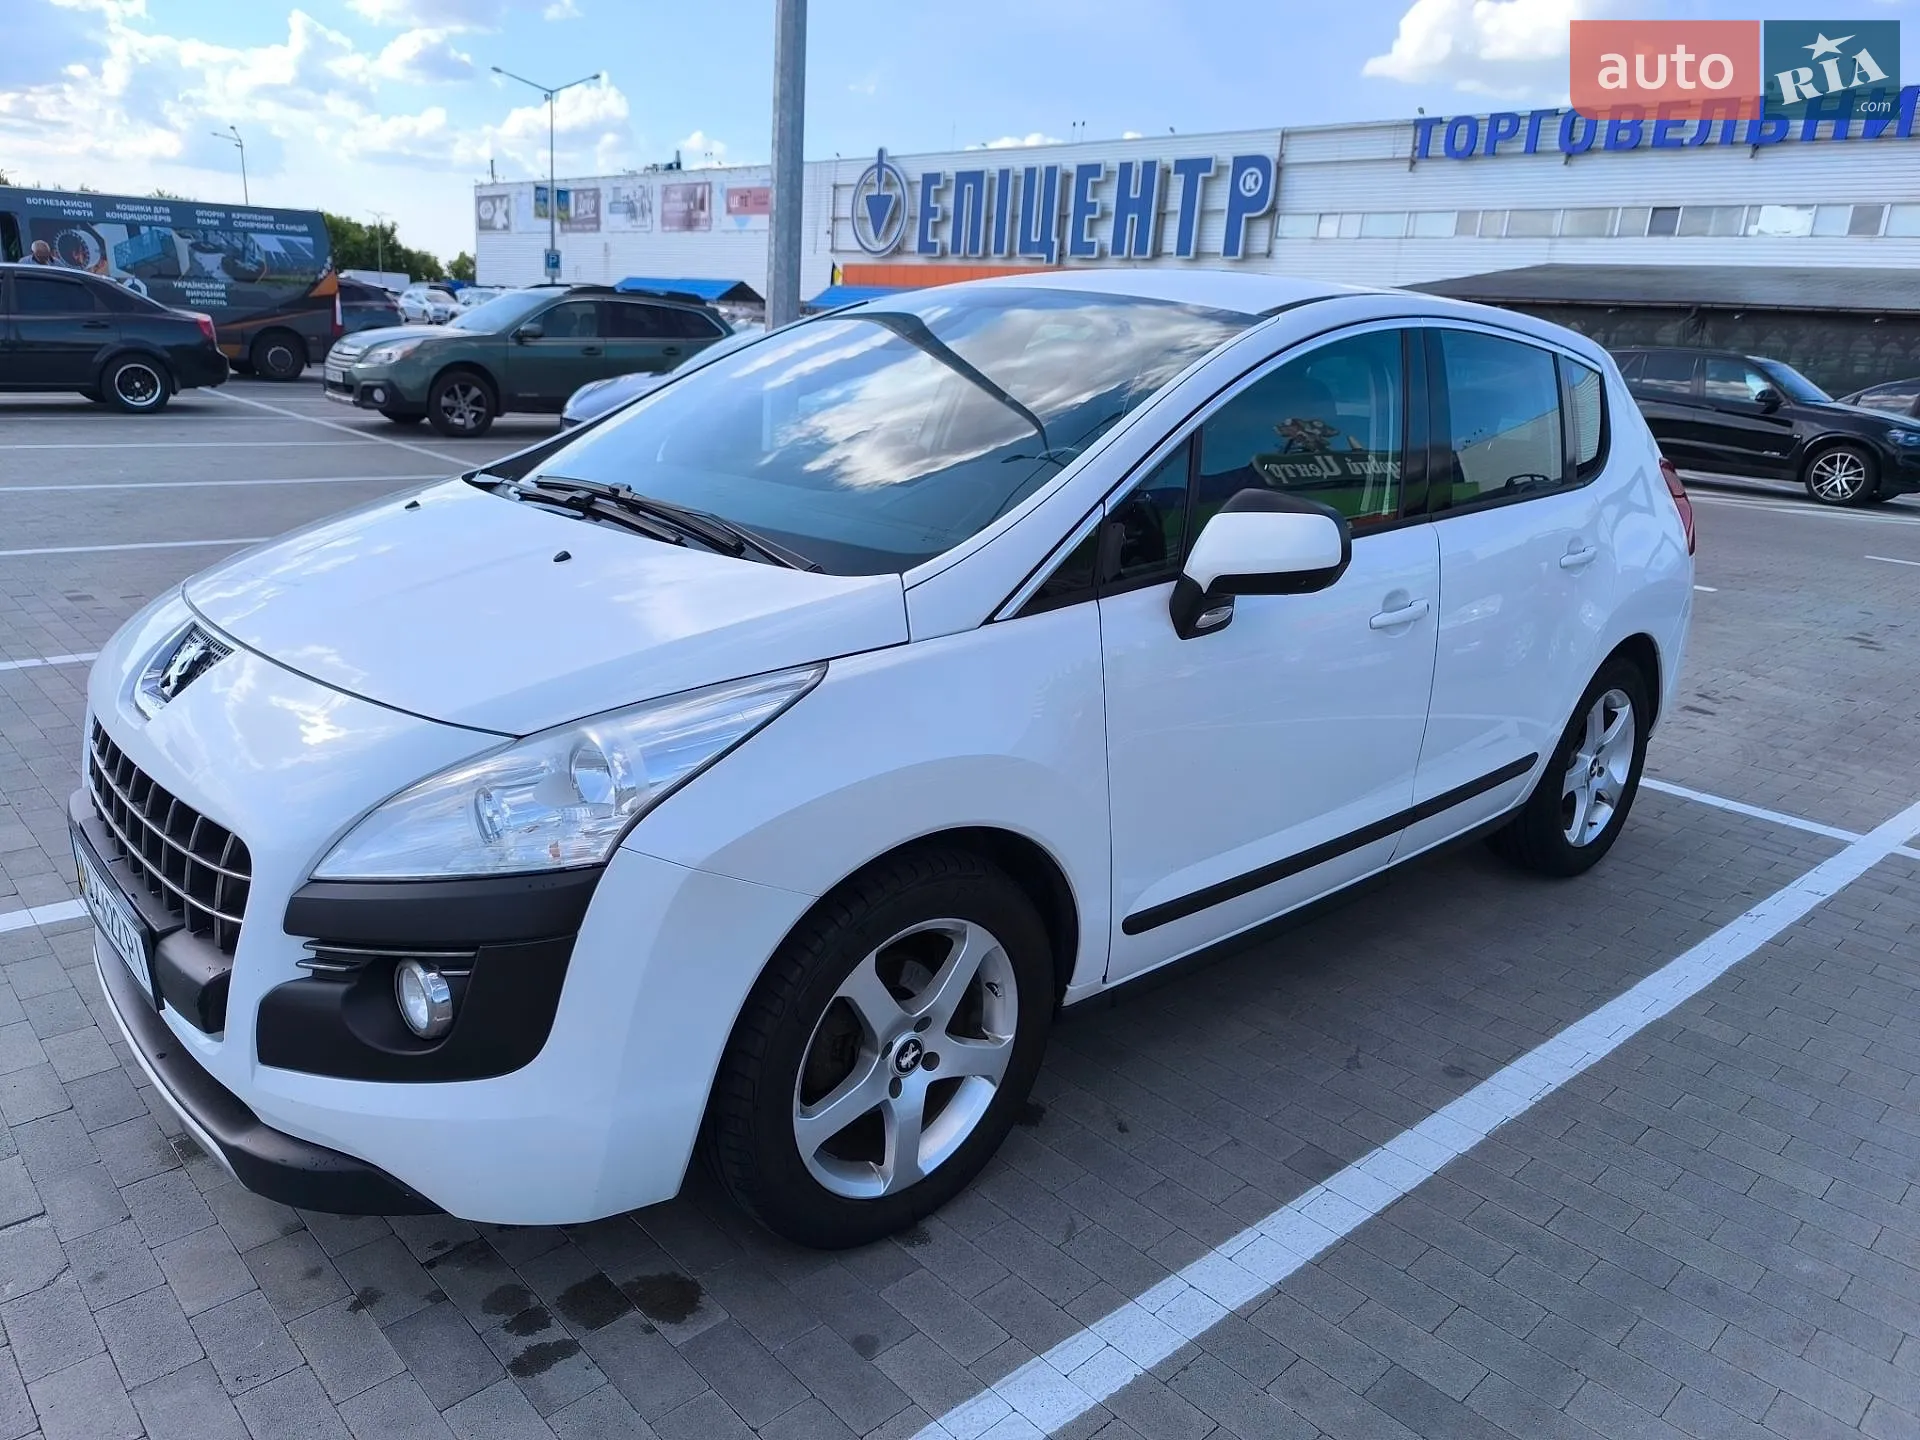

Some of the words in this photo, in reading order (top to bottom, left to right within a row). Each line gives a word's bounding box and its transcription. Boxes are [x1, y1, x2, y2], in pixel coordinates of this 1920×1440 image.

[26, 197, 92, 208] ВОГНЕЗАХИСНІ
[63, 208, 93, 217] МУФТИ
[116, 203, 151, 212] КОШИКИ
[153, 206, 170, 214] ДЛЯ
[916, 154, 1278, 264] ЕПІЦЕНТР
[105, 211, 171, 222] КОНДИЦІОНЕРІВ
[197, 218, 219, 226] РАМИ
[276, 222, 308, 232] СТАНЦІЙ
[172, 280, 226, 290] УКРАЇНСЬКИЙ
[185, 290, 226, 298] ВИРОБНИК
